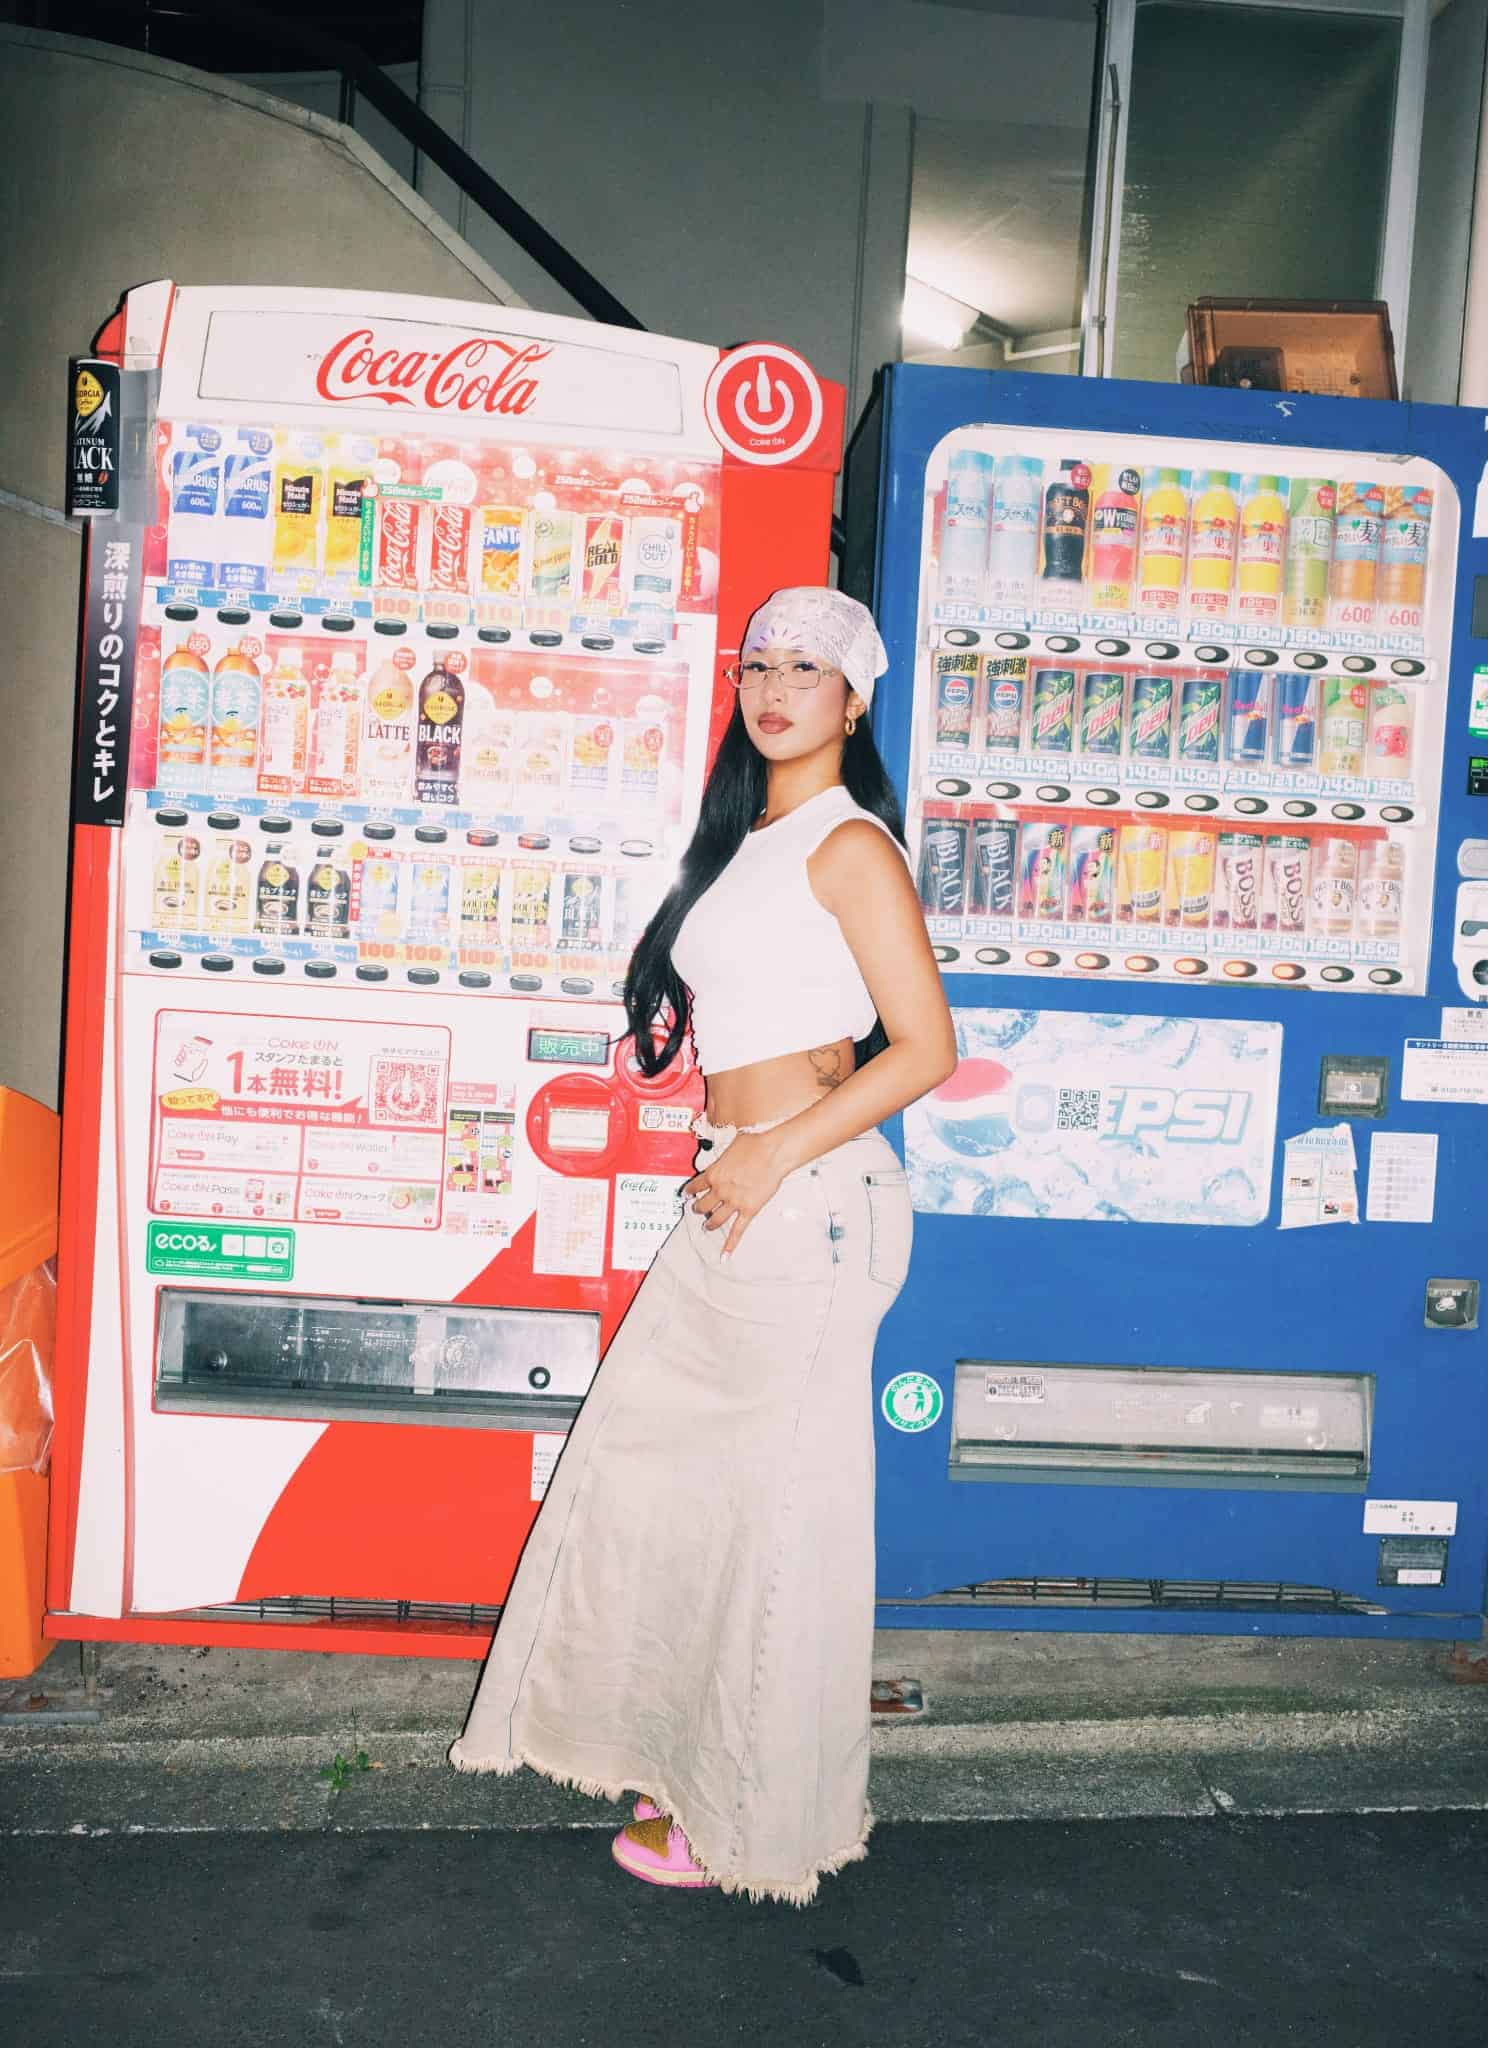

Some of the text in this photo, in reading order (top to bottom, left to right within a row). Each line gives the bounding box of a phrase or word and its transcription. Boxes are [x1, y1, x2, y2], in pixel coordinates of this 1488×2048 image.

[316, 329, 556, 416] Coca-Cola
[73, 447, 113, 471] LACK
[379, 502, 411, 588] Coca-Cola
[431, 503, 465, 592] Coca-Cola
[588, 542, 619, 554] REAL
[642, 544, 668, 553] CHILL
[586, 553, 618, 568] GOLD
[644, 552, 665, 561] OUT
[92, 541, 131, 803] 深煎りのコクとキレ
[937, 655, 978, 673] 強刺激
[986, 658, 1026, 676] 強刺激
[996, 692, 1017, 700] PEPSI
[369, 723, 409, 741] LATTE
[419, 724, 461, 743] BLACK
[1049, 832, 1065, 849] 新
[1098, 832, 1113, 851] 新
[936, 838, 962, 911] BLACK
[986, 832, 1015, 912] BLACK
[1235, 858, 1255, 921] BOSS
[1283, 861, 1301, 922] BOSS
[359, 943, 396, 958] 100
[459, 948, 496, 964] 100
[538, 1040, 600, 1057] 販売中
[255, 1052, 344, 1066] スタンプたまると
[226, 1051, 344, 1100] 1本無料!
[1098, 1085, 1253, 1144] EPSI
